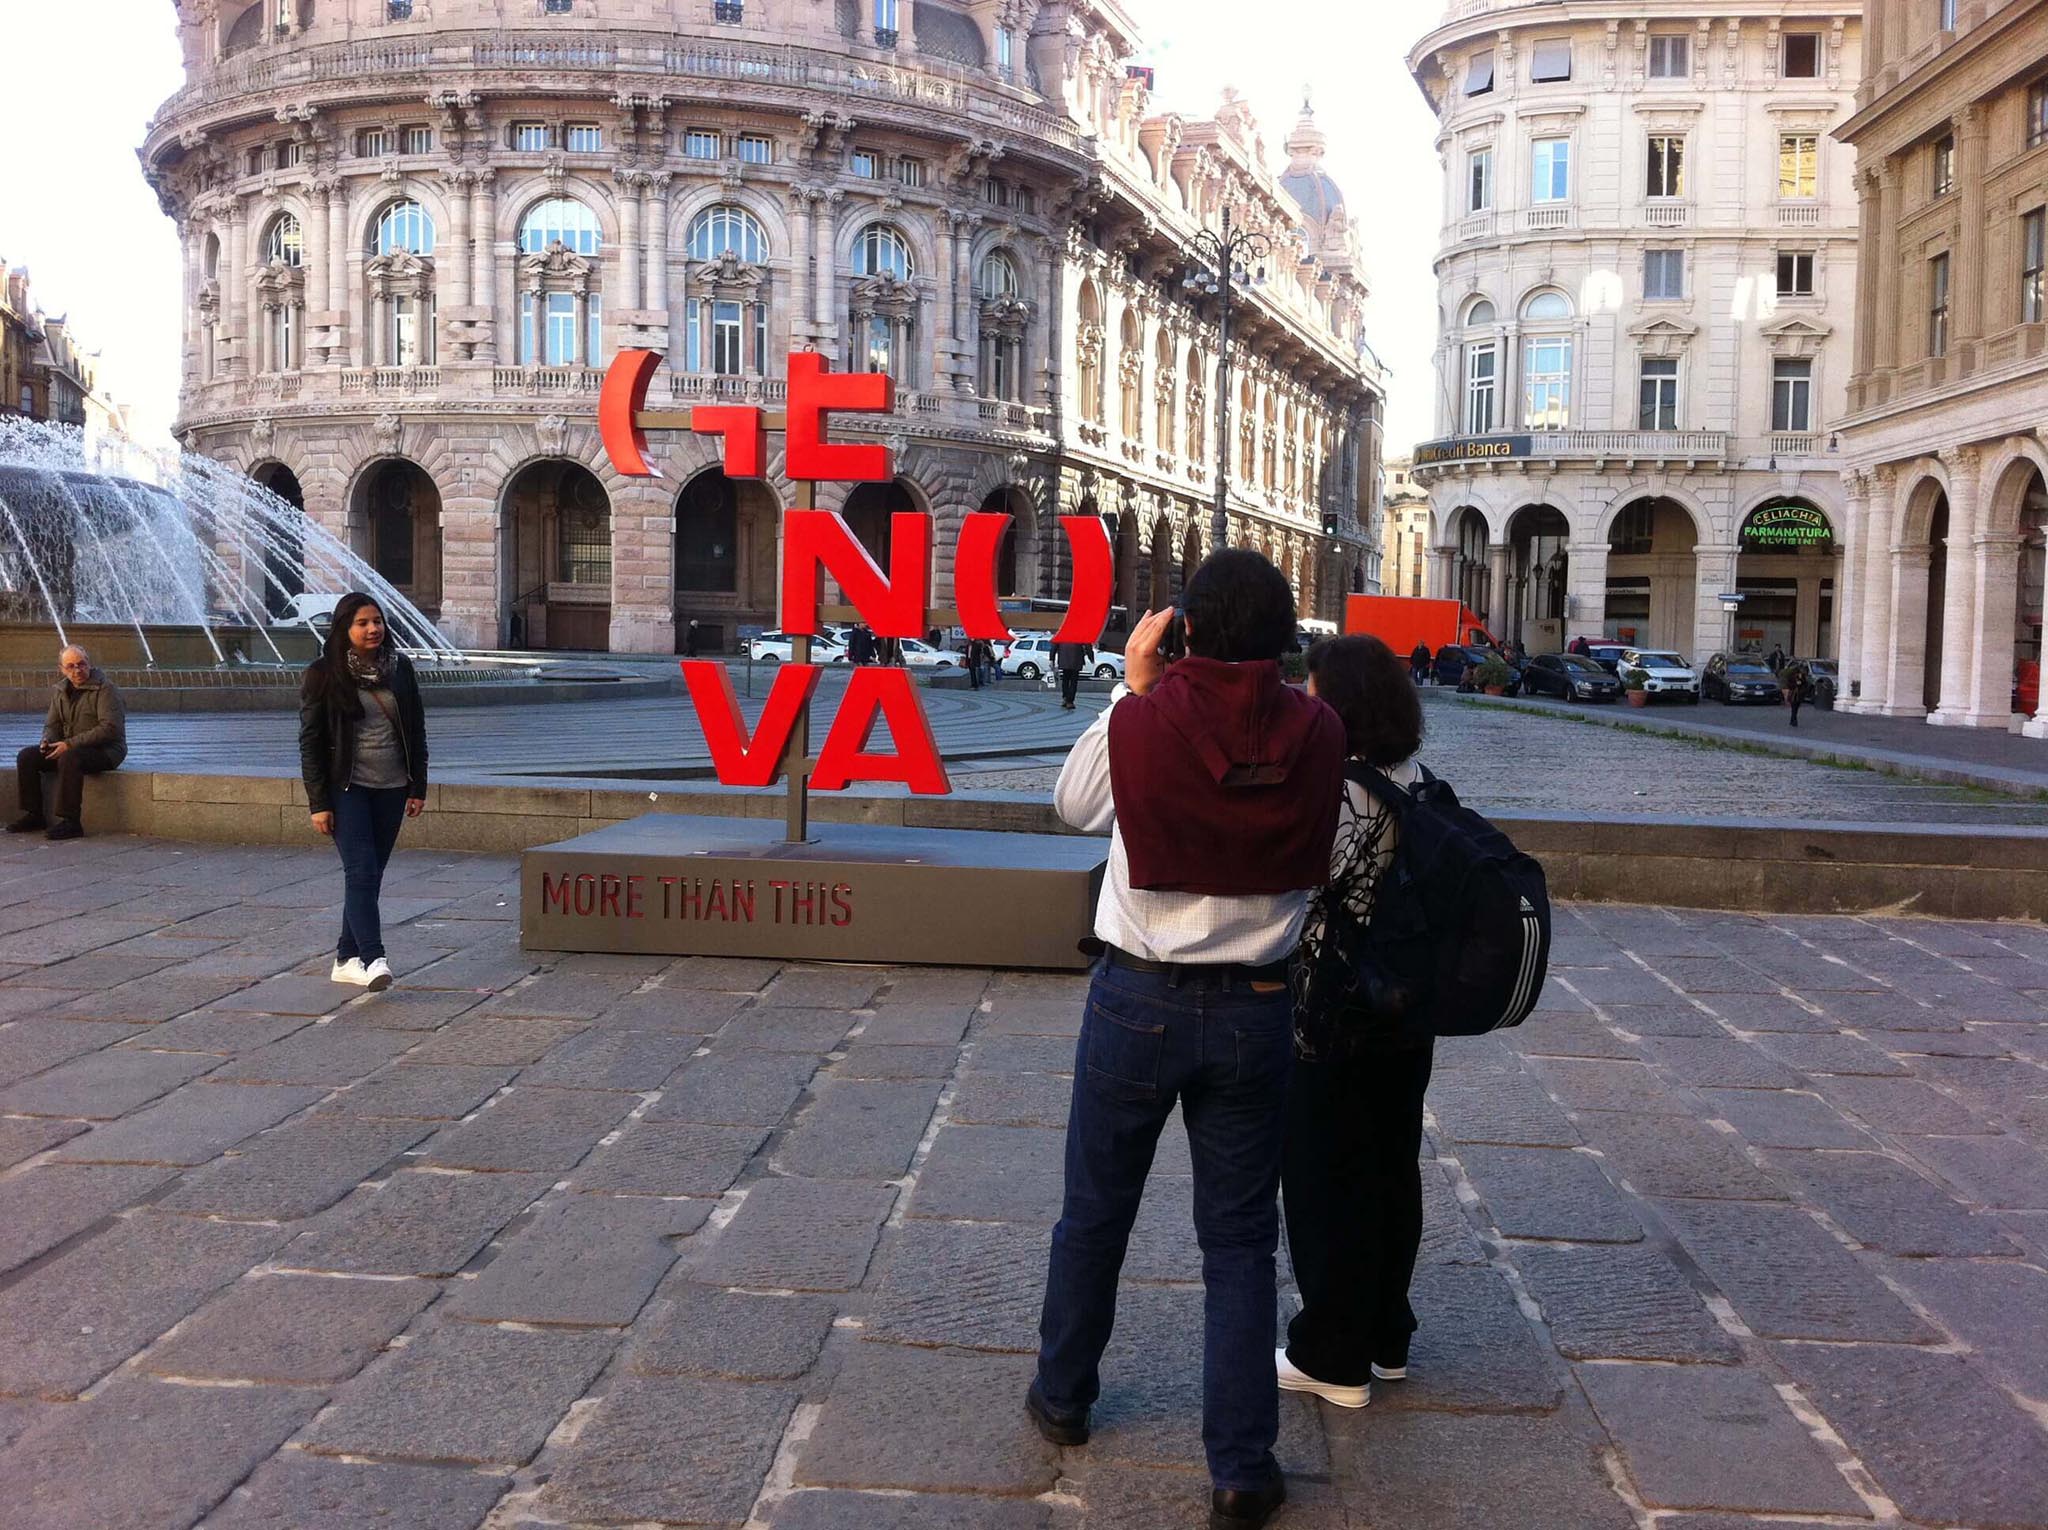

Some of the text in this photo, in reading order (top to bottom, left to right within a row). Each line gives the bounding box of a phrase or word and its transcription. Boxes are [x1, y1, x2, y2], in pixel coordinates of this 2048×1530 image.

[599, 351, 893, 481] GE
[1467, 442, 1511, 456] Banca
[782, 509, 1115, 643] NO
[1744, 526, 1831, 538] FARMANATURA
[680, 660, 951, 795] VA
[543, 872, 853, 927] MORE THAN THIS
